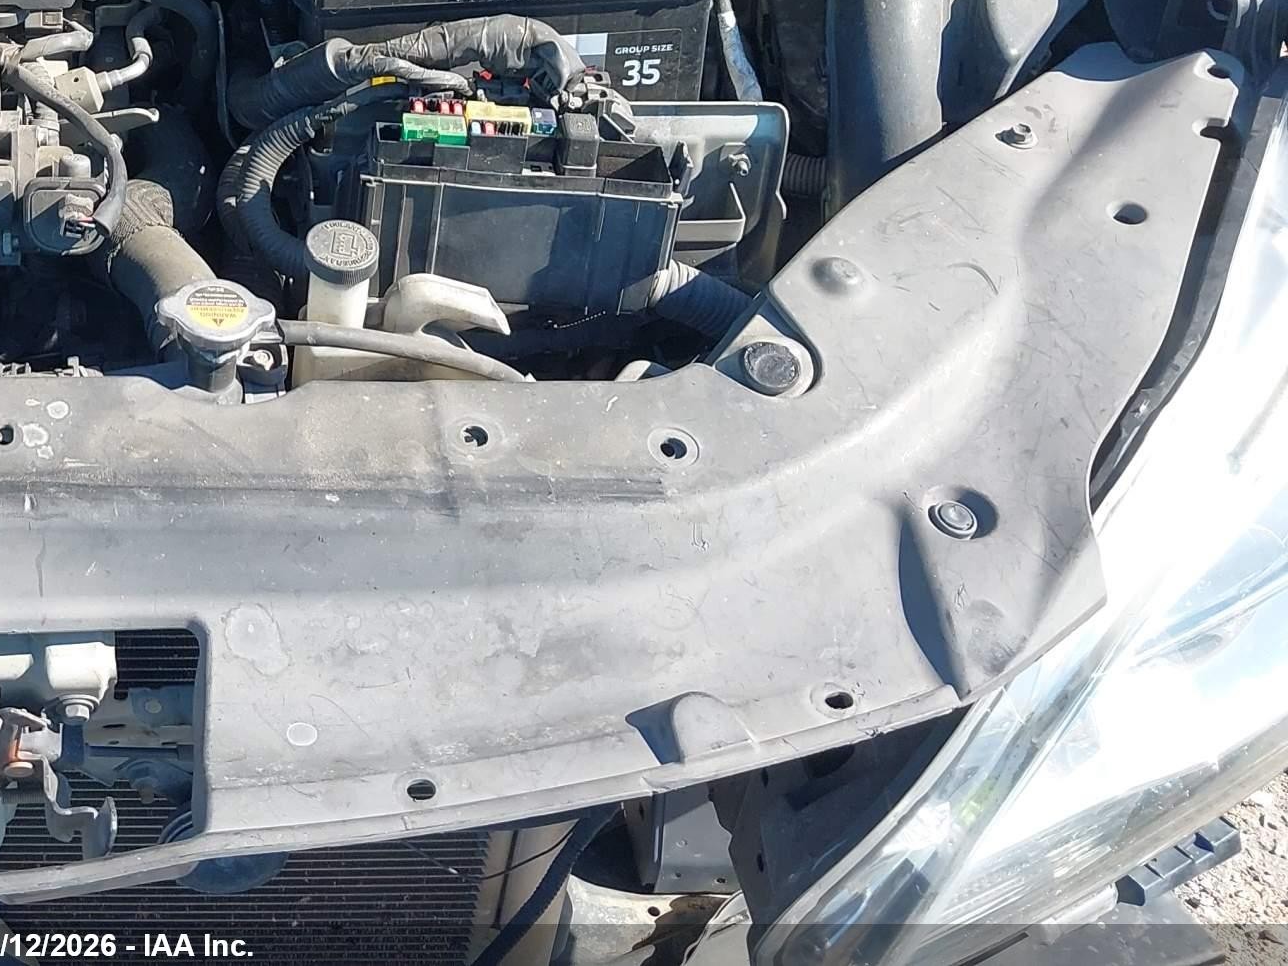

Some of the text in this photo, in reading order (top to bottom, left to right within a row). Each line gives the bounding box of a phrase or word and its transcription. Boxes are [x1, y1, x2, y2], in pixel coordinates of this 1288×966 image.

[615, 43, 674, 55] GROUP SIZE
[622, 58, 661, 87] 35
